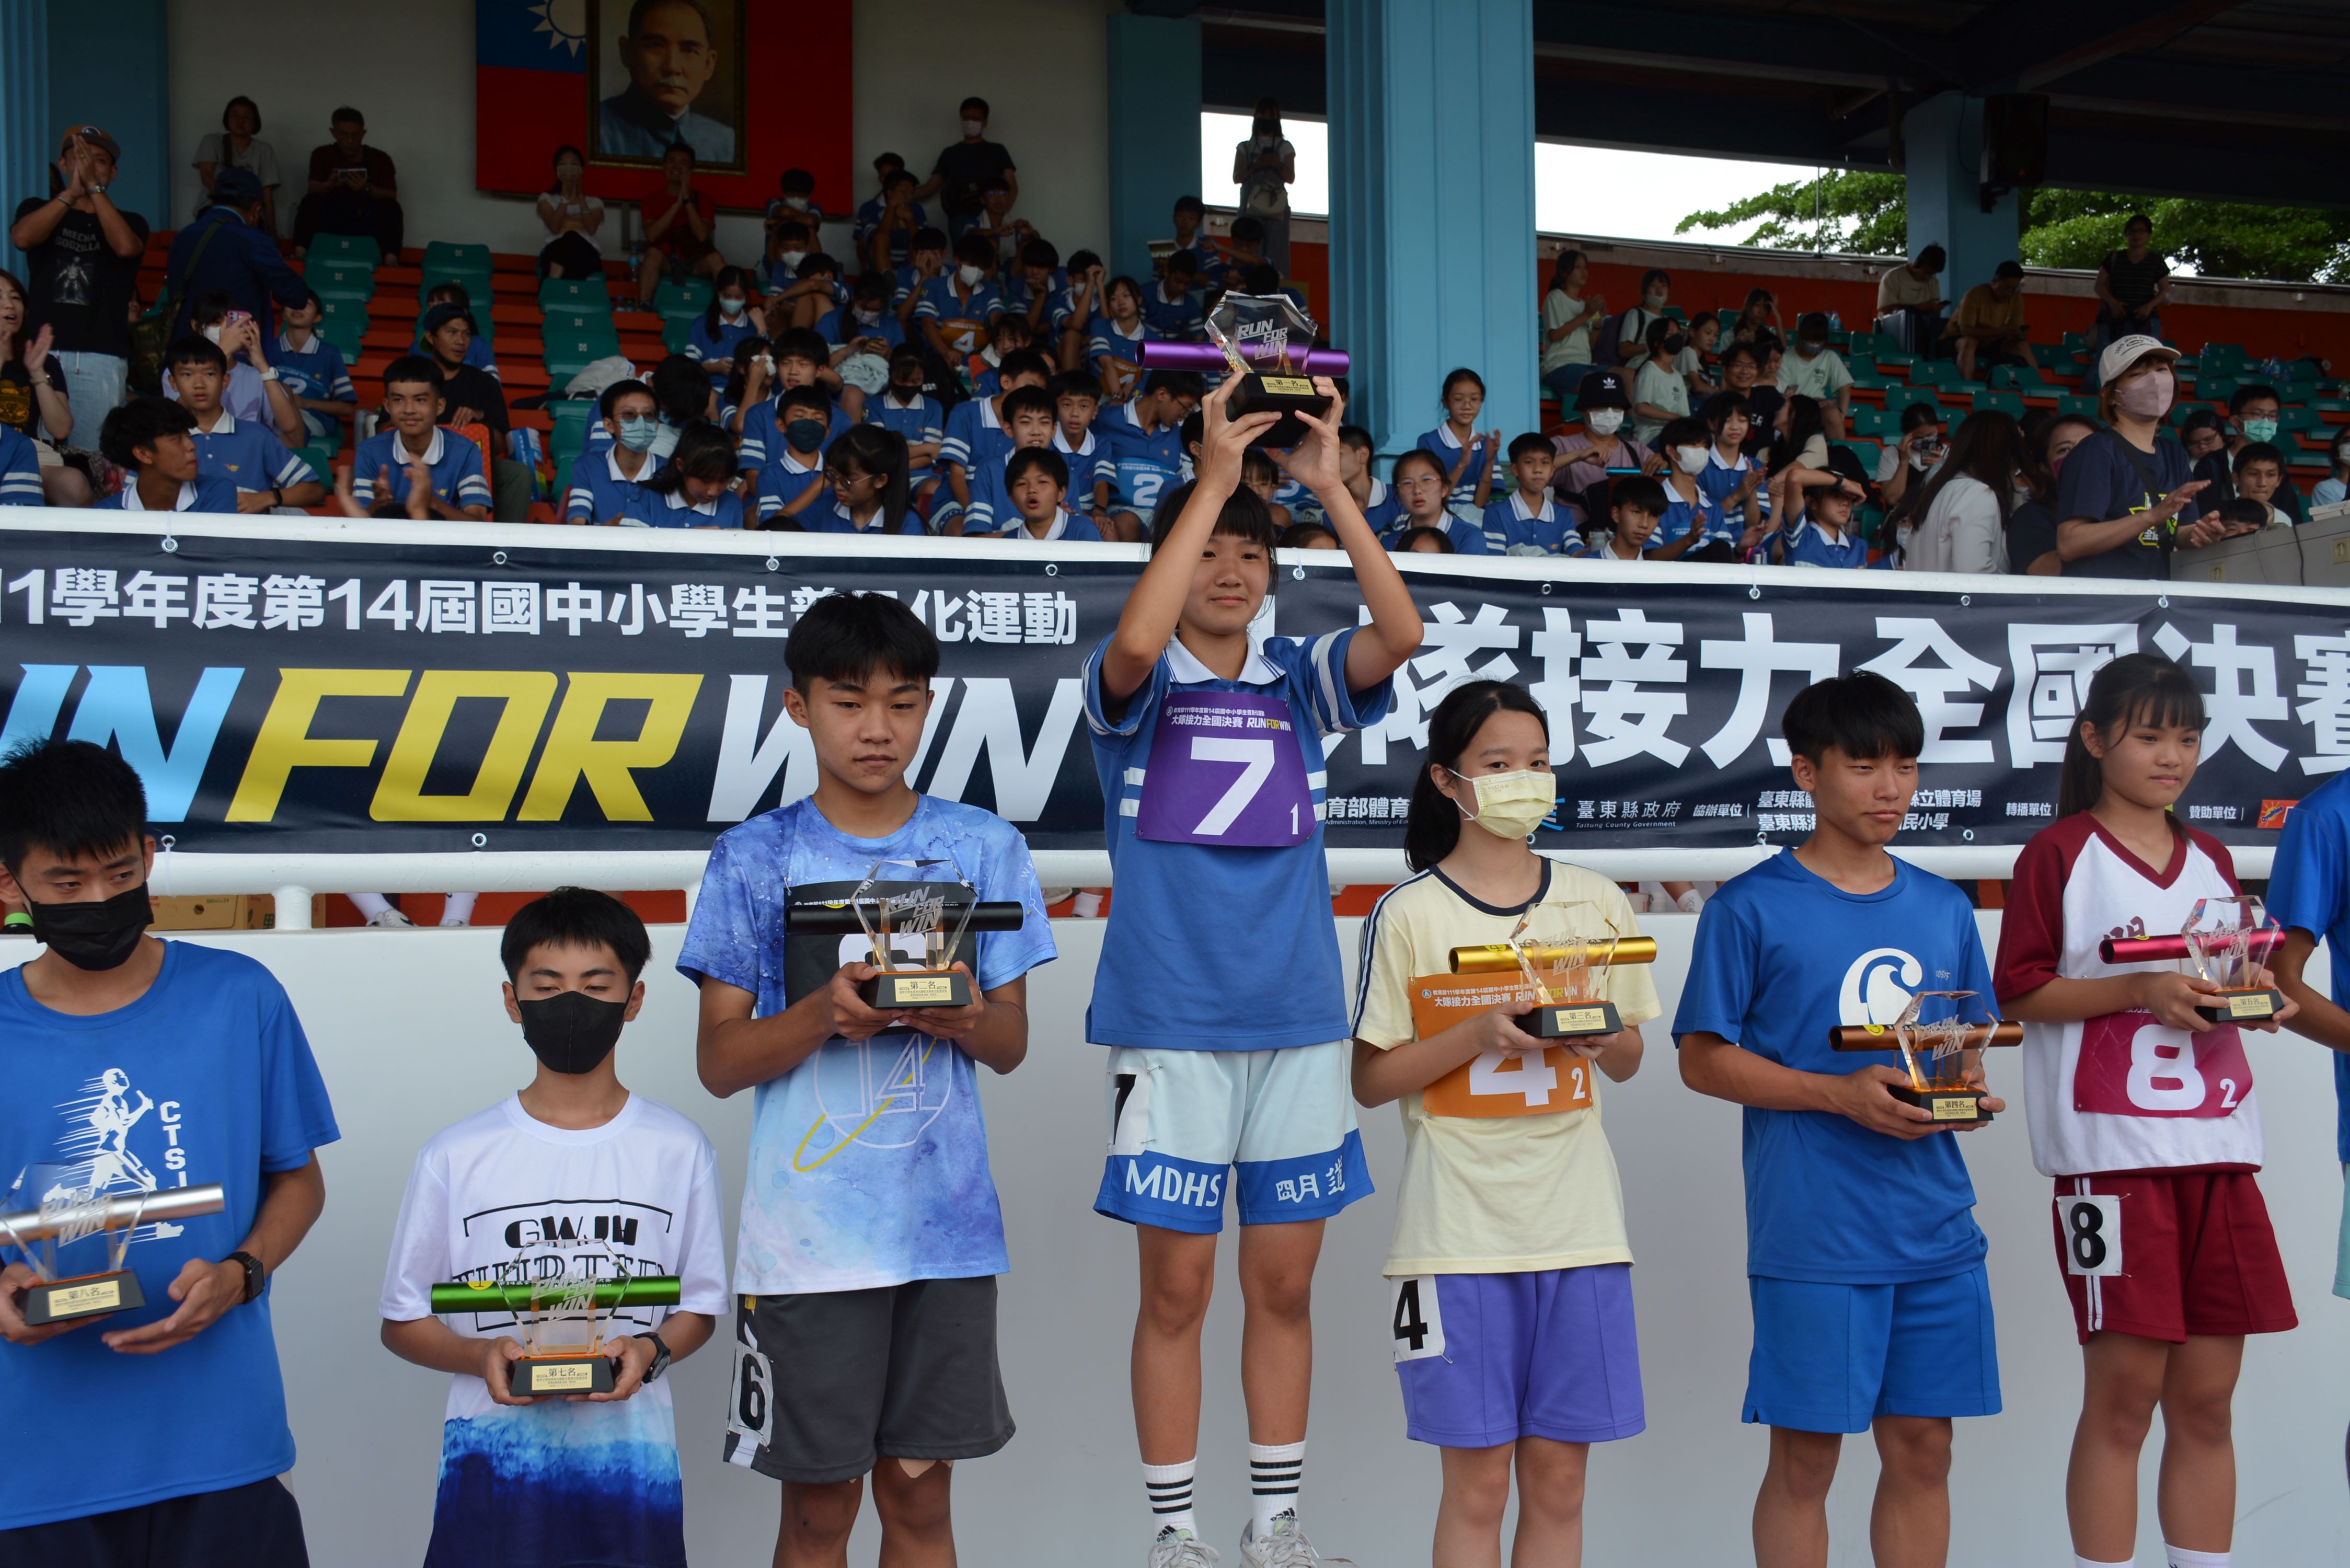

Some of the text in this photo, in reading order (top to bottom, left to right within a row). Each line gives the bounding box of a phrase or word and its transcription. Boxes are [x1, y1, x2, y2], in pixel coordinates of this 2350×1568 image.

[53, 227, 97, 243] MECHA
[54, 236, 101, 252] GODZILLA
[952, 331, 975, 354] 4
[1237, 319, 1273, 340] RUN
[1263, 327, 1288, 343] FOR
[1254, 339, 1287, 360] WIN
[1133, 473, 1164, 506] 2
[0, 568, 1076, 645] 1學年度第14屆國中小學生化運動
[1171, 715, 1243, 728] 大隊接力全國決賽
[224, 668, 705, 822] FOR
[1191, 737, 1274, 835] 7
[1290, 803, 1299, 835] 1
[1325, 797, 1410, 818] 育部體育
[1577, 801, 1682, 819] 臺東縣政府
[1692, 803, 1743, 817] 協辦單位
[2006, 802, 2052, 816] 轉播單位
[1898, 813, 1950, 831] 民小學
[882, 886, 930, 916] RUN
[913, 895, 944, 918] FOR
[899, 907, 942, 939] WIN
[1552, 948, 1587, 976] WIN
[2220, 939, 2250, 962] WIN
[910, 981, 936, 990] 第二名
[1435, 994, 1512, 1007] 大隊接力全國決賽
[1931, 1035, 1966, 1061] WIN
[1469, 1047, 1558, 1106] 4
[2126, 1024, 2206, 1111] 8
[1571, 1067, 1586, 1100] 2
[2219, 1078, 2238, 1108] 2
[1114, 1074, 1137, 1145] 7
[1125, 1159, 1222, 1207] MDHS
[59, 1212, 108, 1248] WIN
[505, 1215, 639, 1249] GWJH
[2069, 1202, 2106, 1269] 8
[68, 1287, 100, 1300] 第八名
[548, 1292, 595, 1321] WIN
[1393, 1279, 1429, 1351] 4
[549, 1368, 576, 1377] 第七名
[738, 1353, 766, 1431] 6
